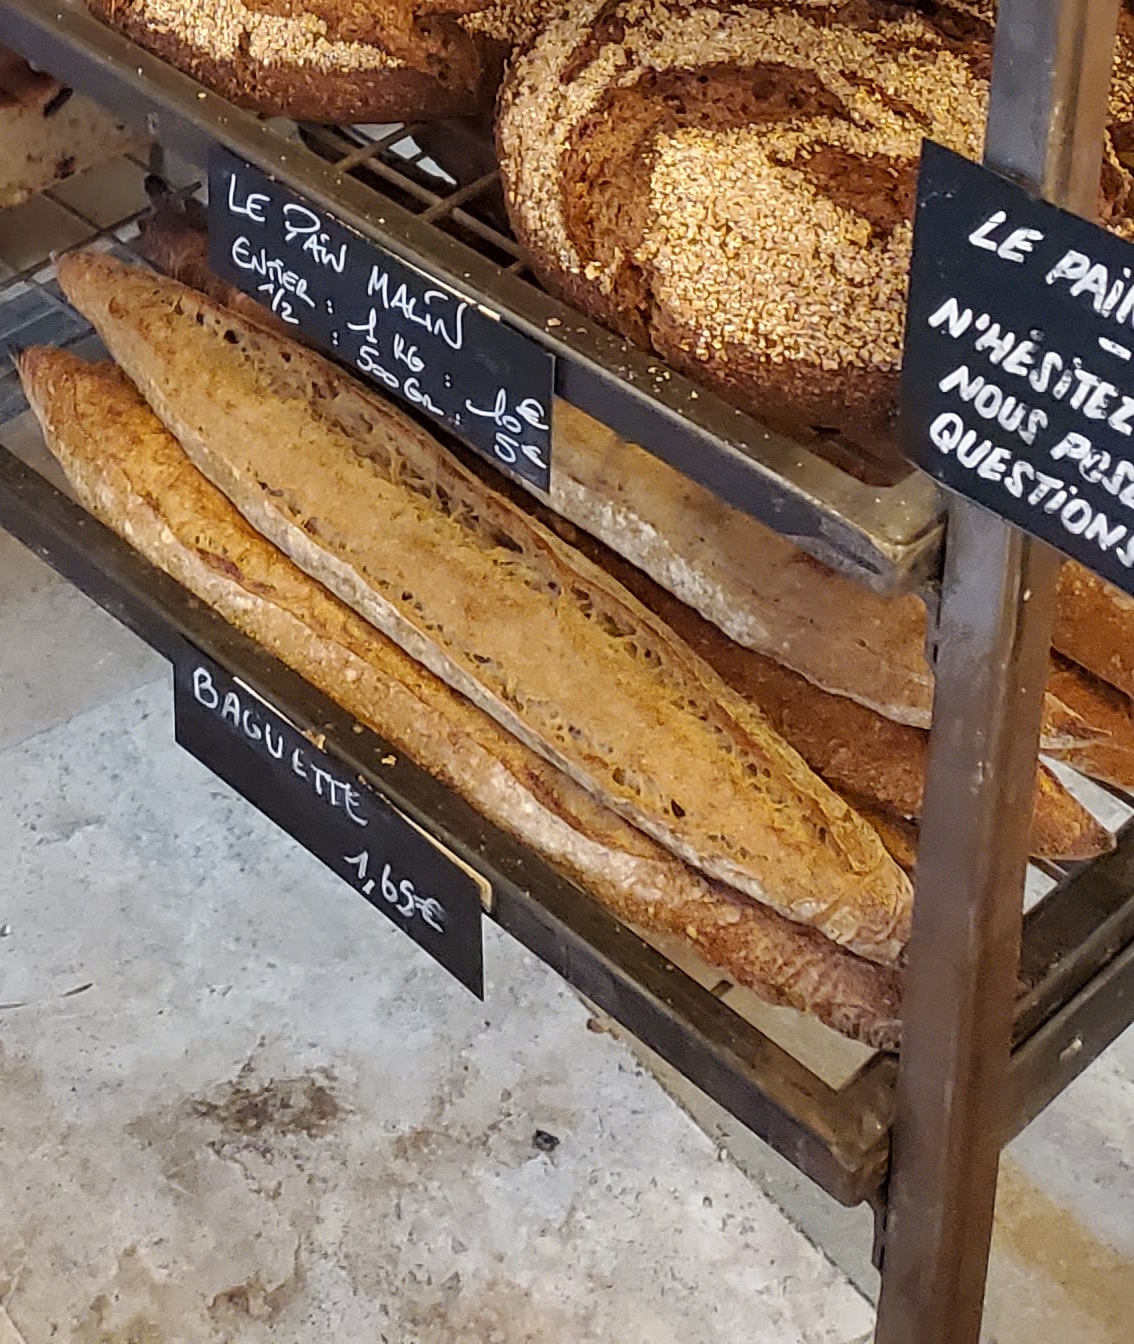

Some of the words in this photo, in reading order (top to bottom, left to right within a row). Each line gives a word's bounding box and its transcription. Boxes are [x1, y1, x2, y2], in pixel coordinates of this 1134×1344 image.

[227, 173, 271, 222] LE
[968, 210, 1045, 263] LE
[393, 333, 425, 373] KG
[938, 365, 1049, 446] NOUS
[192, 666, 369, 827] BAGUETTE
[343, 850, 446, 934] 1,65€
